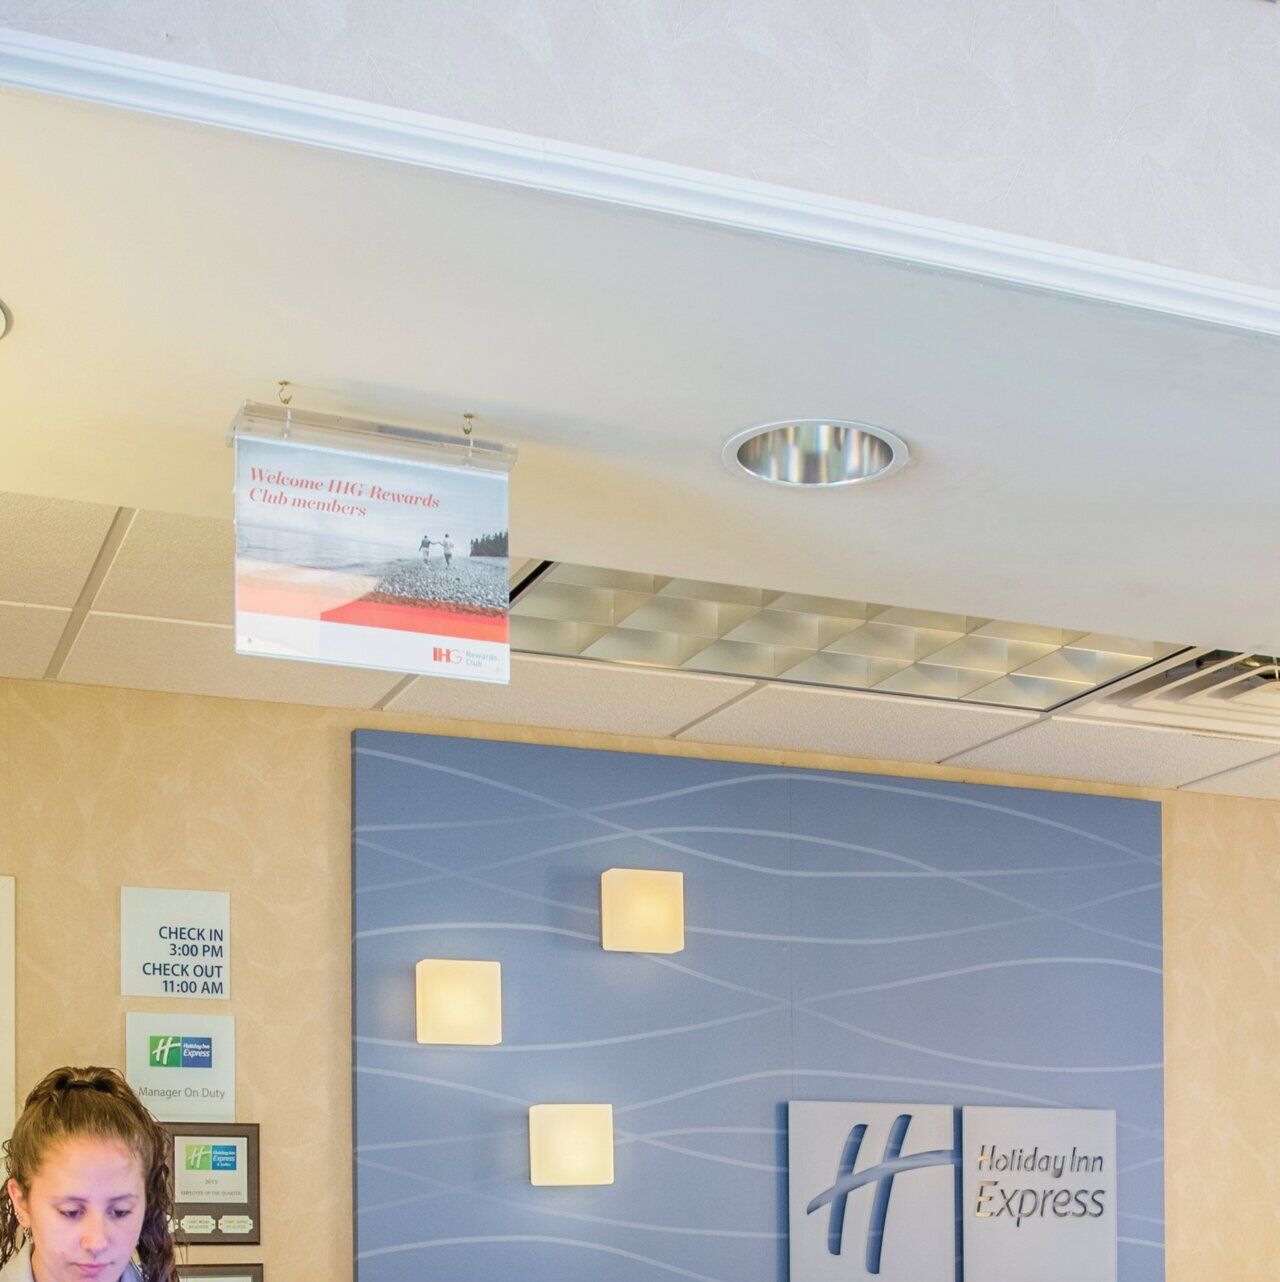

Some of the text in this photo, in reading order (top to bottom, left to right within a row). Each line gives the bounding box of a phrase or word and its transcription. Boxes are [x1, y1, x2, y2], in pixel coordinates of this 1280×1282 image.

[250, 467, 440, 509] Welcome IHG Rewards
[249, 487, 367, 517] Club members
[433, 647, 463, 664] IHG
[159, 926, 223, 942] CHECK IN
[169, 943, 223, 958] 3:00 PM
[142, 962, 223, 978] CHECK OUT
[163, 980, 223, 994] 11:00 AM
[183, 1048, 210, 1058] Express
[139, 1086, 225, 1100] Manager On Duty
[977, 1144, 1103, 1178] Holiday Inn
[976, 1180, 1106, 1228] Express
